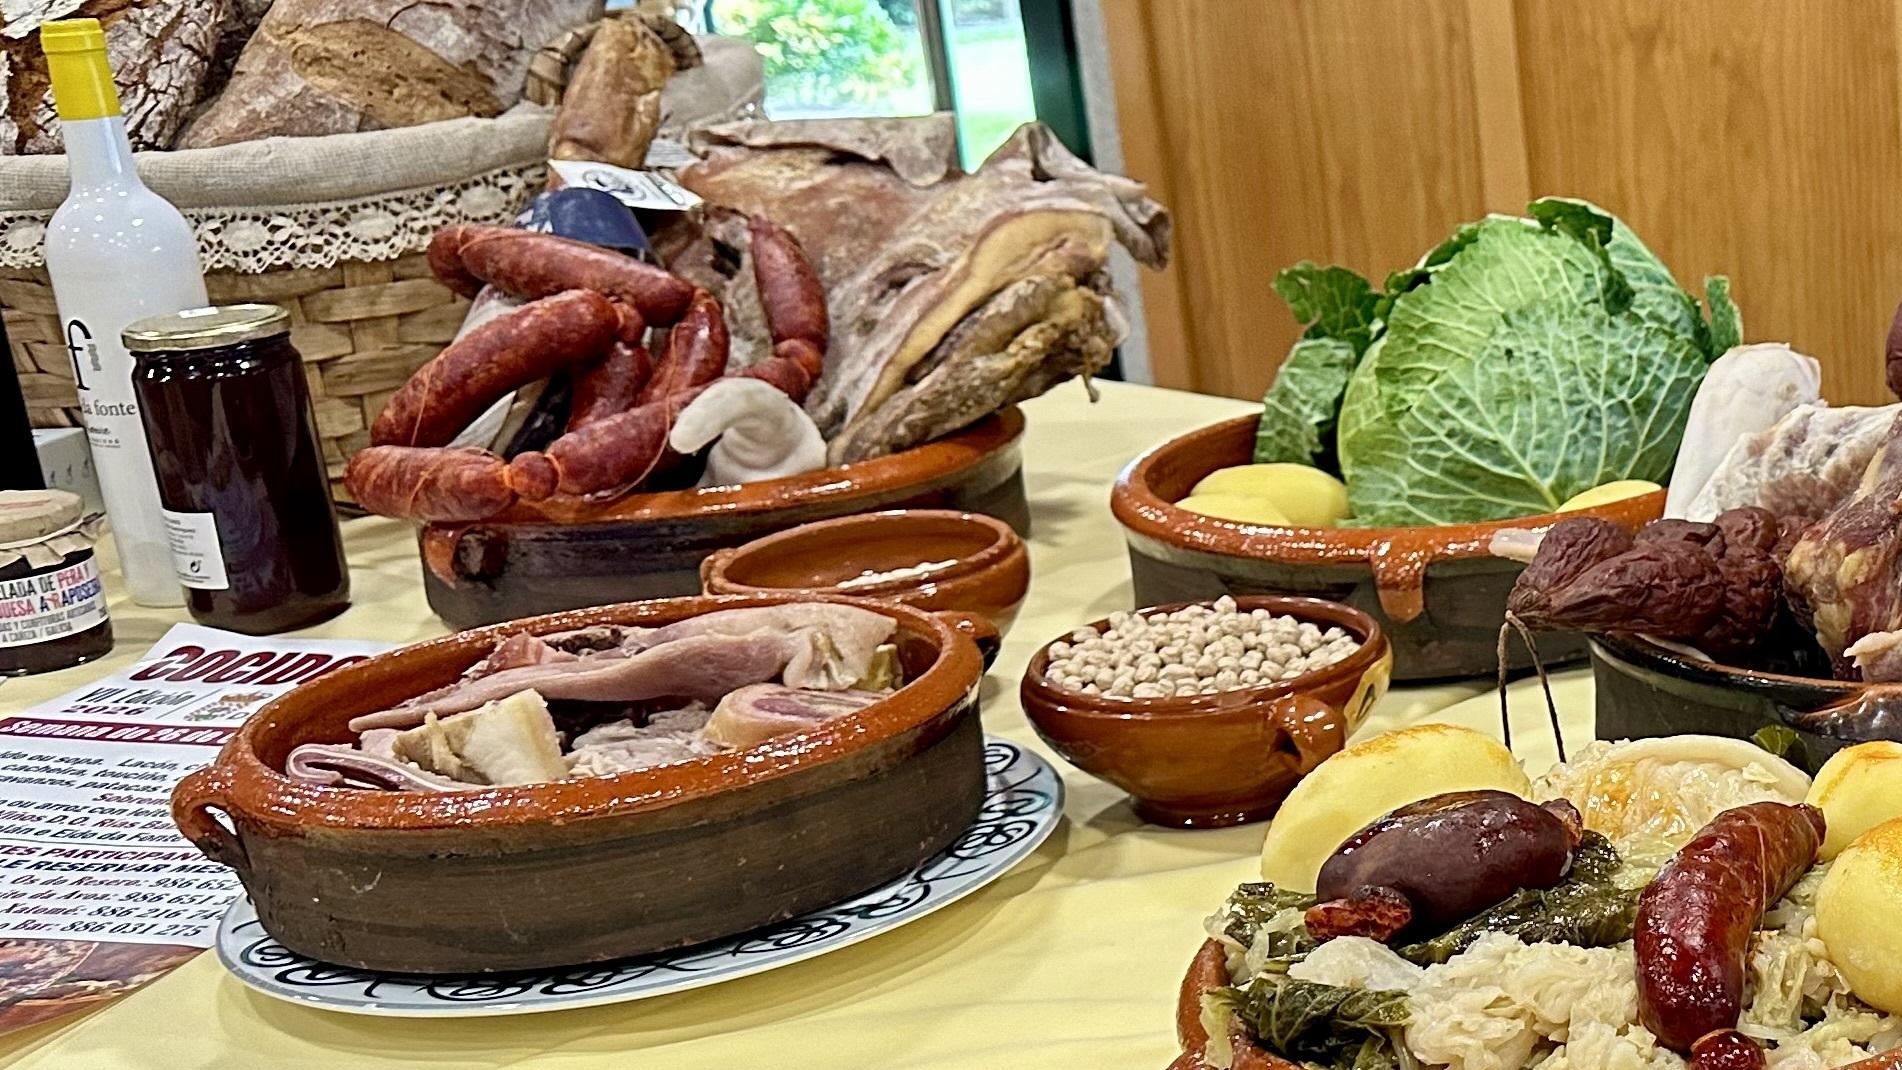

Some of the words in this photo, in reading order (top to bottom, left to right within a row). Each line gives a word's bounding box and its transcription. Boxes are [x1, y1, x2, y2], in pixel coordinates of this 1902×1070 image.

[94, 400, 137, 417] fonte
[38, 574, 56, 594] DE
[116, 688, 197, 707] Edición
[61, 705, 150, 715] 2026
[3, 720, 107, 739] Semana
[45, 815, 90, 827] D.O.
[25, 860, 171, 873] RESERVAR
[60, 921, 111, 933] 886
[108, 923, 159, 934] 031
[153, 925, 209, 937] 275
